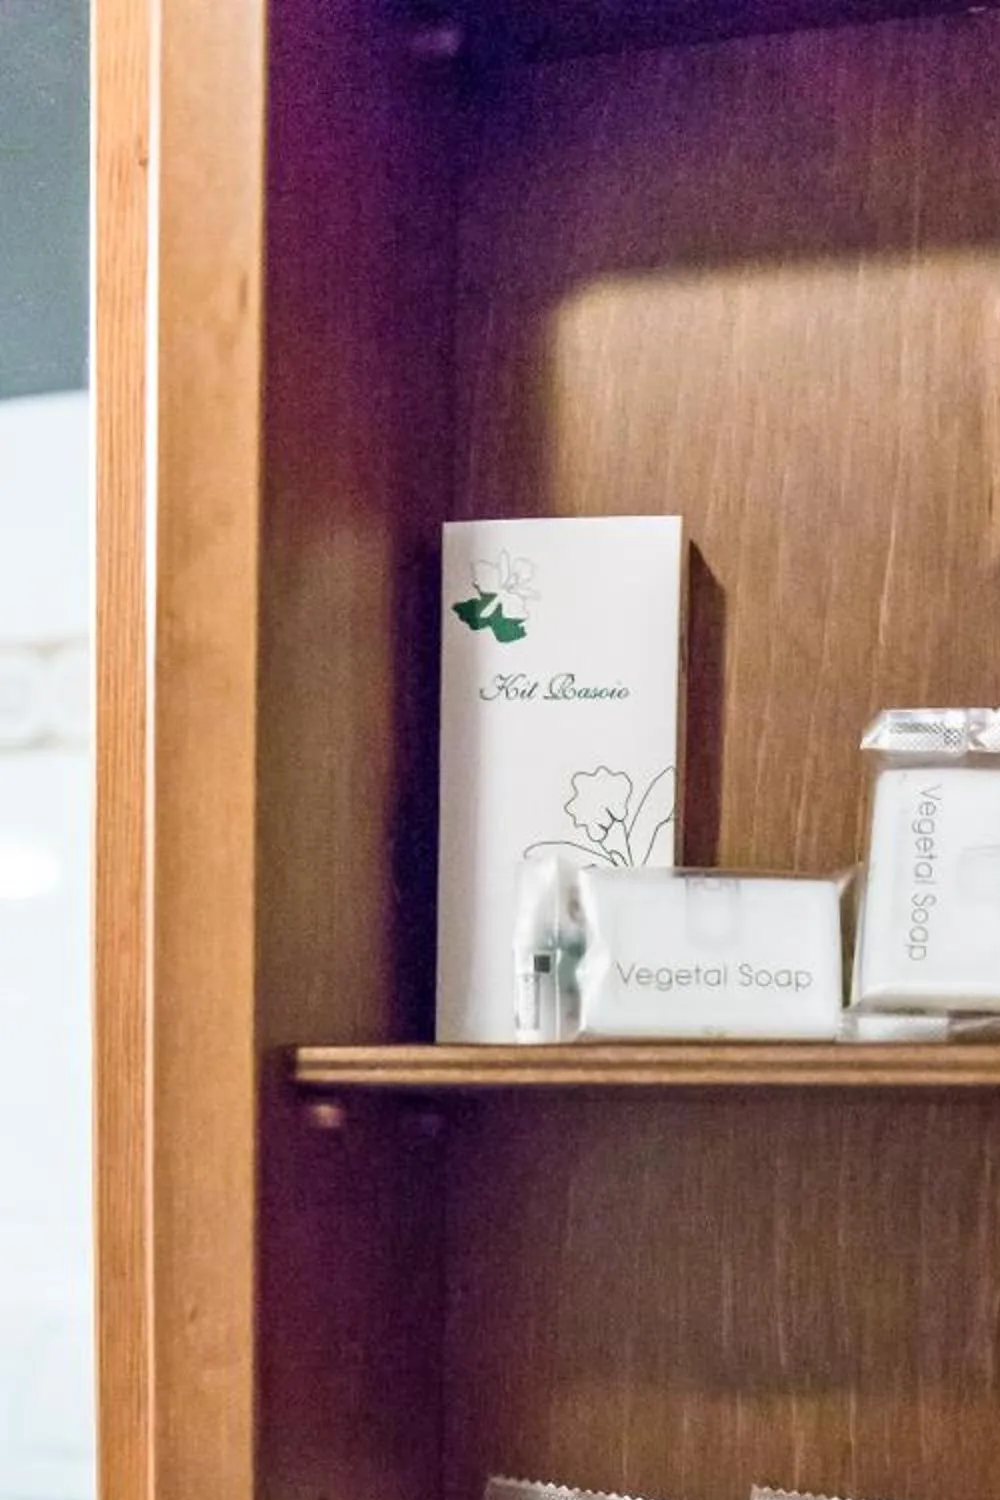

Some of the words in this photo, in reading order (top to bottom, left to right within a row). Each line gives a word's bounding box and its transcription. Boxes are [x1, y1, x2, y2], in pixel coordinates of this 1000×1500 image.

[543, 672, 631, 701] Rasoio
[911, 783, 943, 885] Vegetal
[904, 893, 937, 962] Soap
[615, 961, 729, 991] Vegetal
[738, 962, 814, 992] Soap
